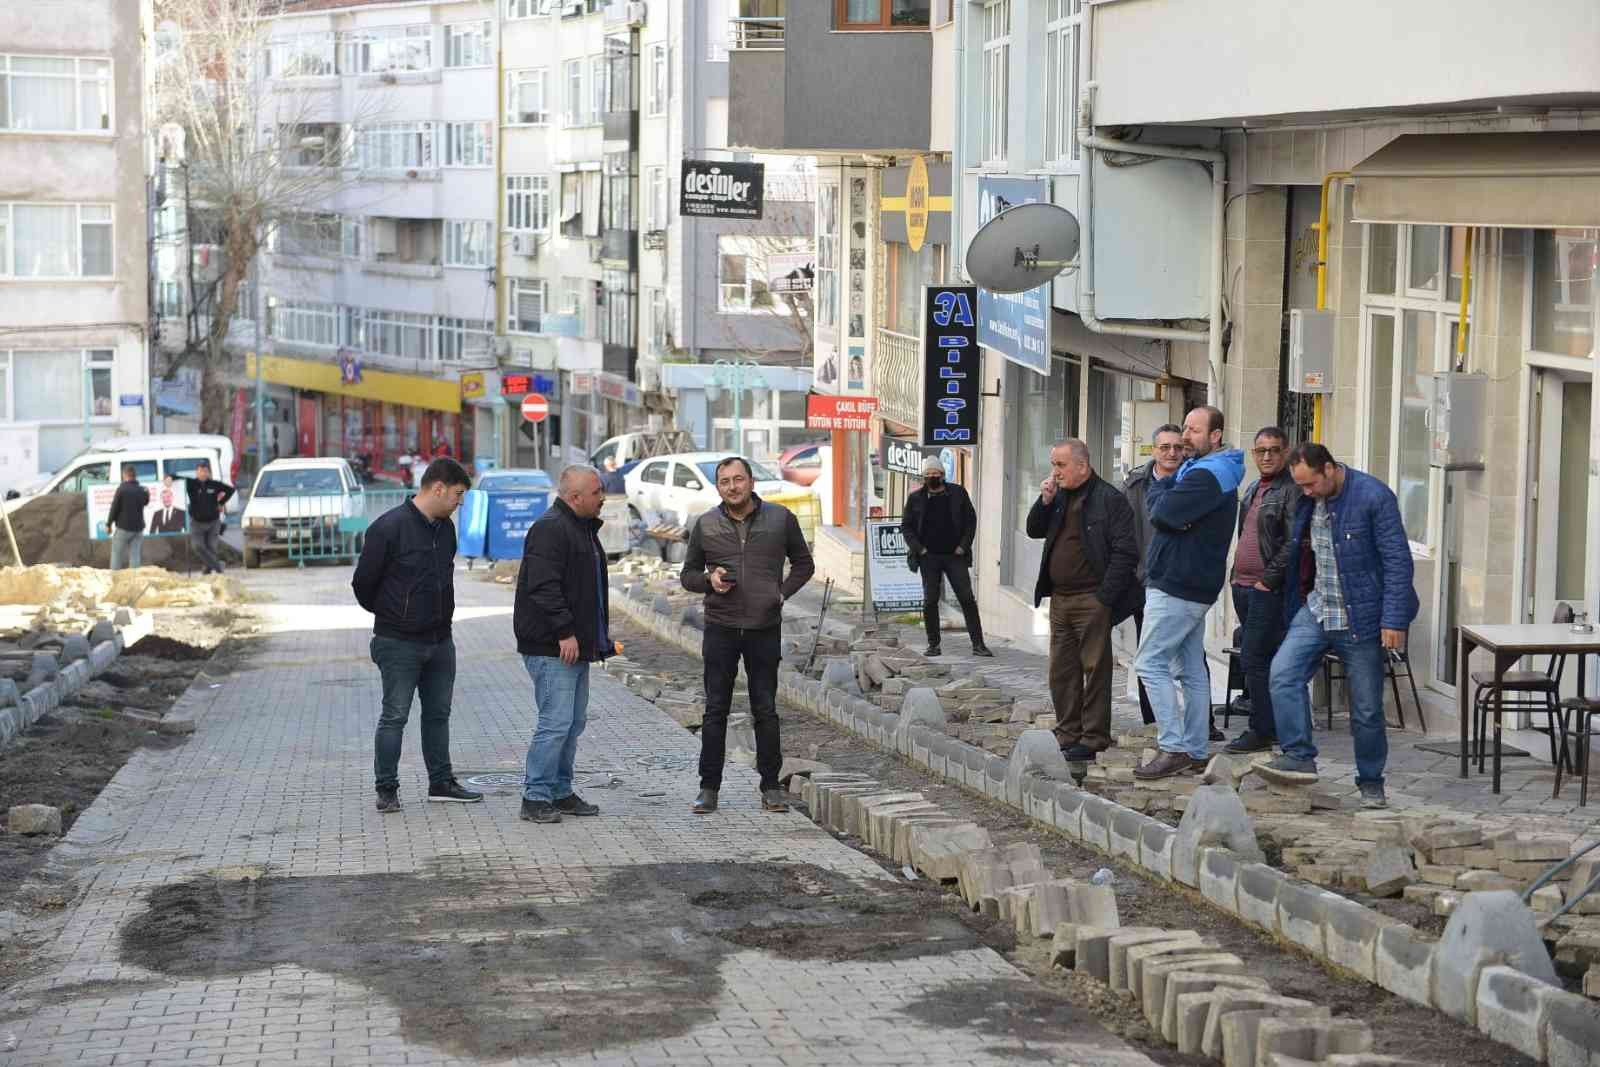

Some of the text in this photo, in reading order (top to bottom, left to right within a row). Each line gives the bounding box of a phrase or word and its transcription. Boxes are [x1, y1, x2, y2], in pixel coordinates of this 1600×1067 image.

[685, 167, 751, 202] desinler
[933, 291, 975, 326] 3A
[833, 418, 842, 429] VE
